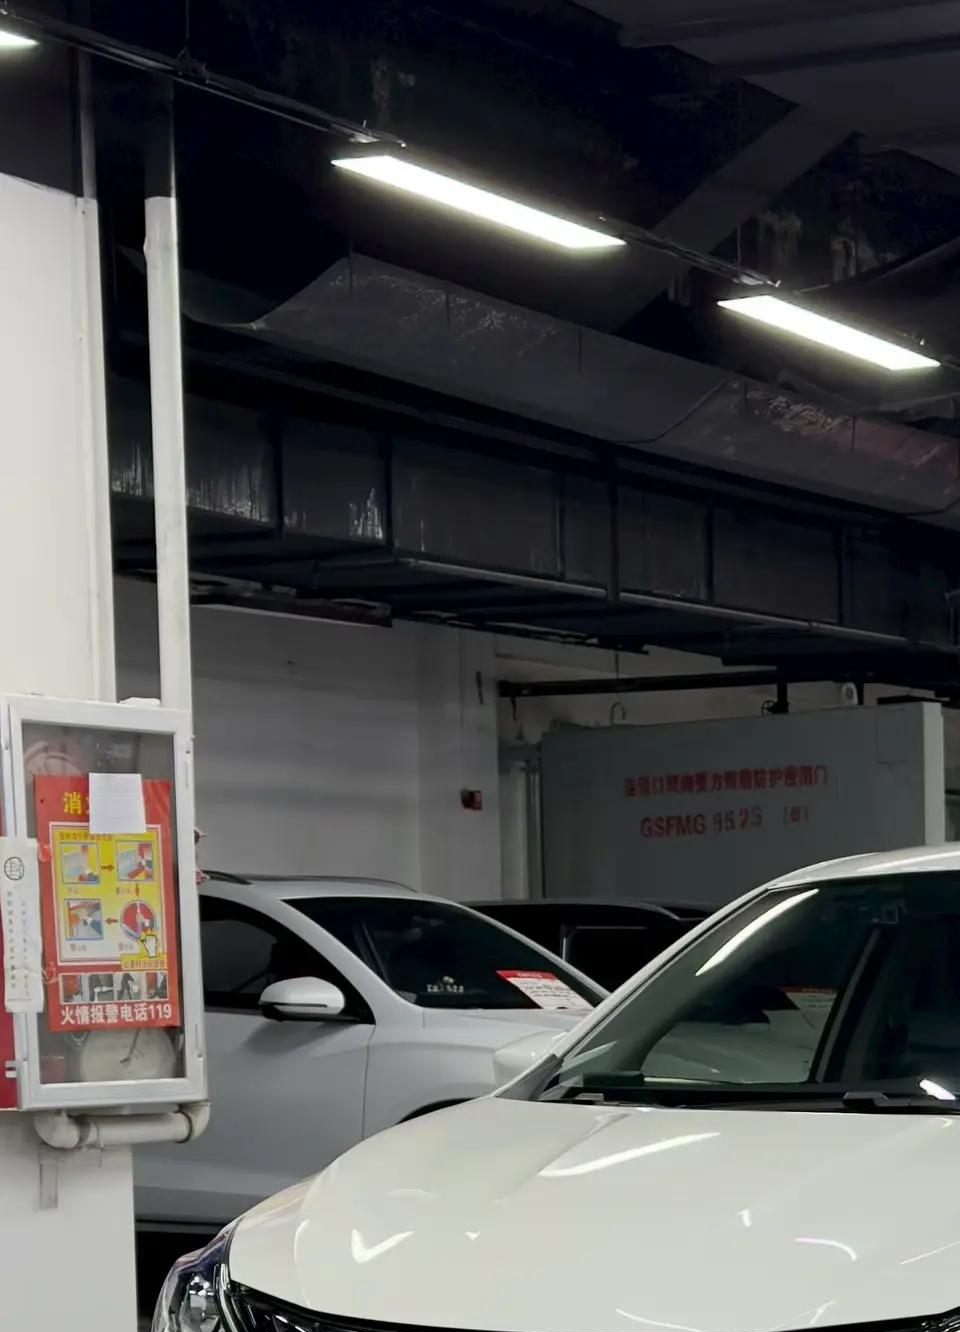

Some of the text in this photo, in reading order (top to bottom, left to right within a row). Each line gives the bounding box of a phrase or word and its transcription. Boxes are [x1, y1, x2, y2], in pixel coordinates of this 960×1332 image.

[640, 813, 707, 839] GSFMG
[60, 1002, 172, 1026] 火情报警电话119
